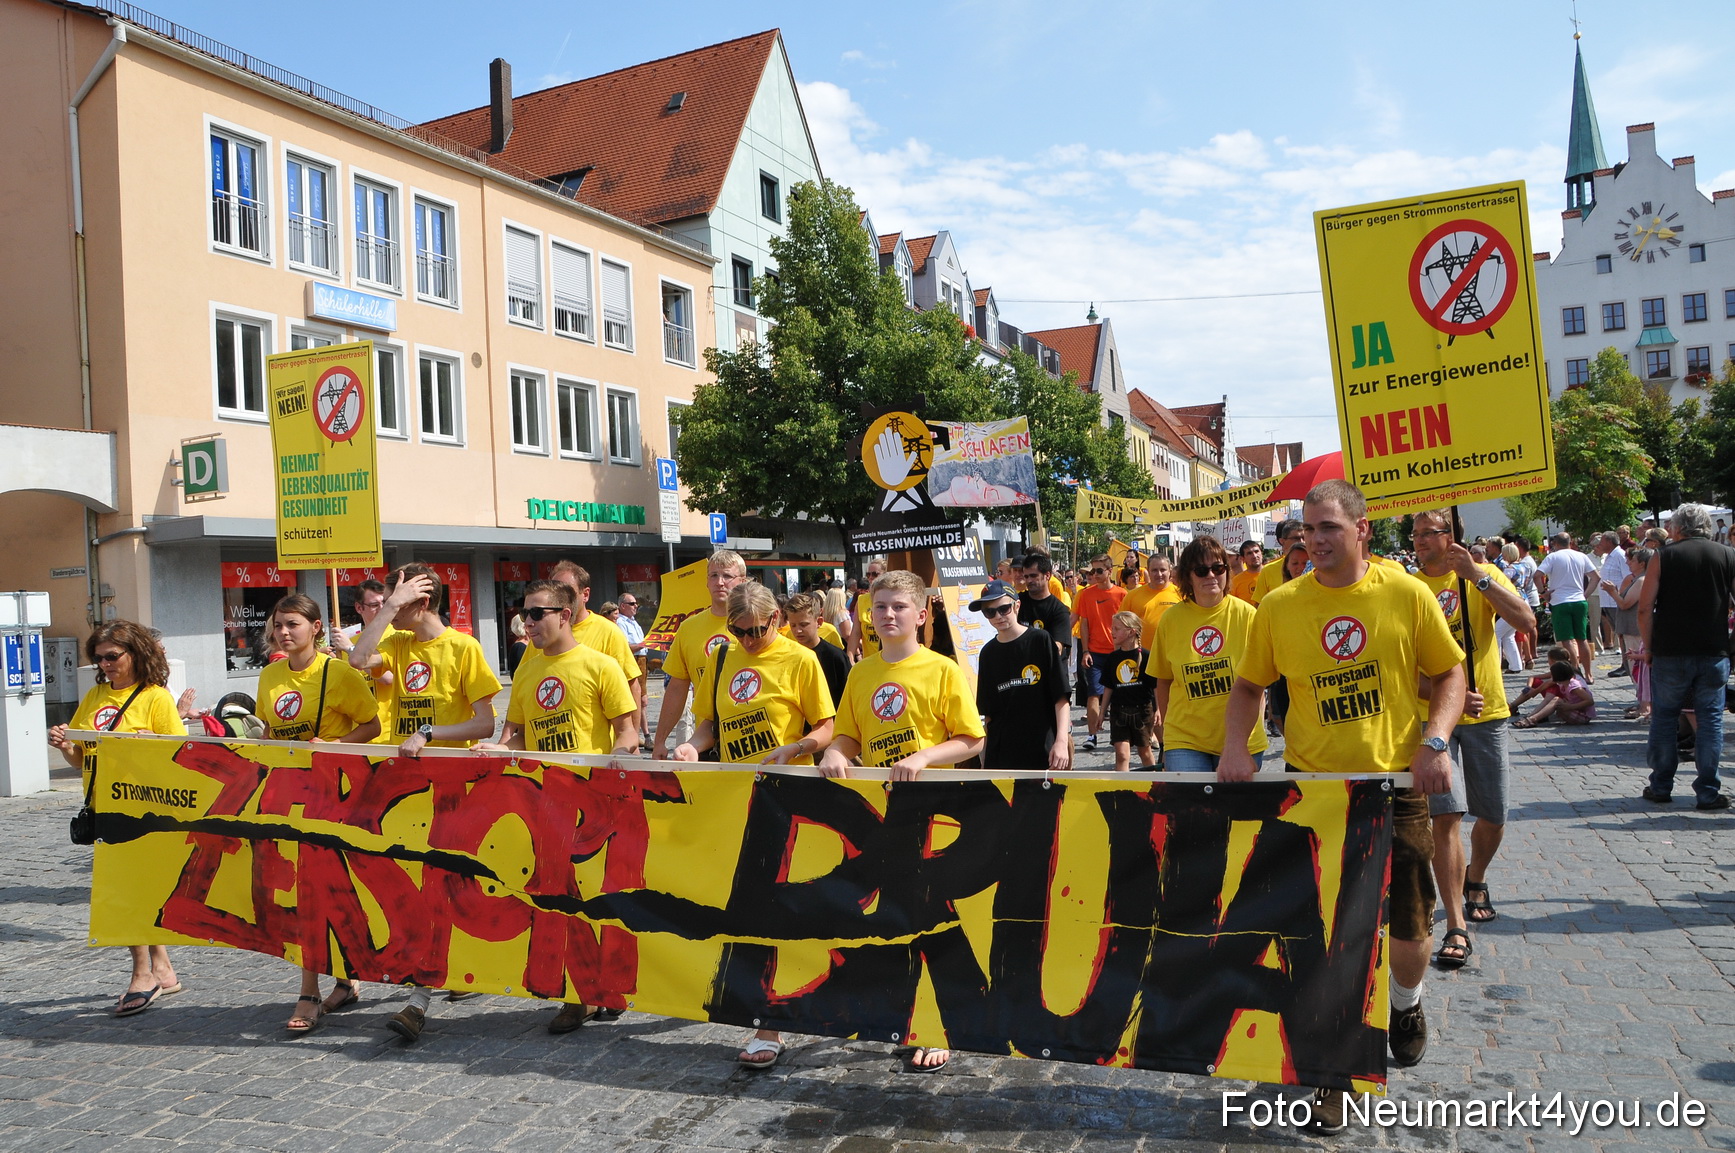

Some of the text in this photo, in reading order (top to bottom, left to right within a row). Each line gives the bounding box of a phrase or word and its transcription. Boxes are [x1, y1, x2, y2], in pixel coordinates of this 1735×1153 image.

[1326, 194, 1515, 231] Bürger gegen Strommonstertrasse
[1351, 321, 1395, 369] JA
[270, 350, 367, 370] Bürger gegen Strommonstertrasse
[1349, 353, 1530, 396] zur Energiewende!
[276, 385, 304, 398] Wir sagen
[278, 394, 307, 416] NEIN!
[1360, 403, 1452, 459] NEIN
[959, 432, 1031, 458] SCHLAFEN
[188, 450, 214, 486] D
[281, 453, 319, 474] HEIMAT
[1360, 444, 1524, 486] zum Kohlestrom!
[282, 468, 369, 496] LEBENSQUALITÄT
[661, 463, 673, 486] P
[1160, 479, 1279, 512] AMPRION BRINGT
[1366, 475, 1544, 512] www.freystadt-gegen-stromtrasse.de
[283, 496, 348, 518] GESUNDHEIT
[1089, 508, 1122, 522] 17.01
[1090, 500, 1122, 511] WAHN
[1218, 504, 1246, 519] DEN
[284, 527, 333, 540] schützen!
[713, 517, 723, 540] P
[852, 531, 876, 540] Landkreis
[903, 526, 918, 534] OHNE
[920, 523, 960, 532] Monstertrassen
[1195, 522, 1216, 536] Stoppt
[1222, 520, 1243, 532] Hilfe
[853, 532, 962, 554] TRASSENWAHN.DE
[1222, 531, 1245, 544] Horst
[285, 556, 376, 565] www.freystadt-gegen-stromtrasse.de
[941, 566, 984, 577] TRASSENWAHN.DE
[230, 605, 255, 618] Weil
[1185, 659, 1229, 675] Freystadt
[1202, 671, 1216, 679] sagt
[1315, 665, 1377, 689] Freystadt
[1188, 676, 1232, 698] NEIN!
[1339, 682, 1359, 694] sagt
[1321, 689, 1381, 723] NEIN!
[273, 723, 311, 737] Freystadt
[533, 712, 571, 731] Freystadt
[546, 727, 558, 735] sagt
[723, 711, 765, 733] Freystadt
[740, 725, 756, 735] sagt
[537, 731, 575, 752] NEIN!
[727, 730, 776, 760] NEIN!
[870, 729, 916, 753] Freystadt
[885, 745, 901, 757] sagt
[111, 781, 198, 808] STROMTRASSE
[702, 775, 1393, 1092] BRUTAL
